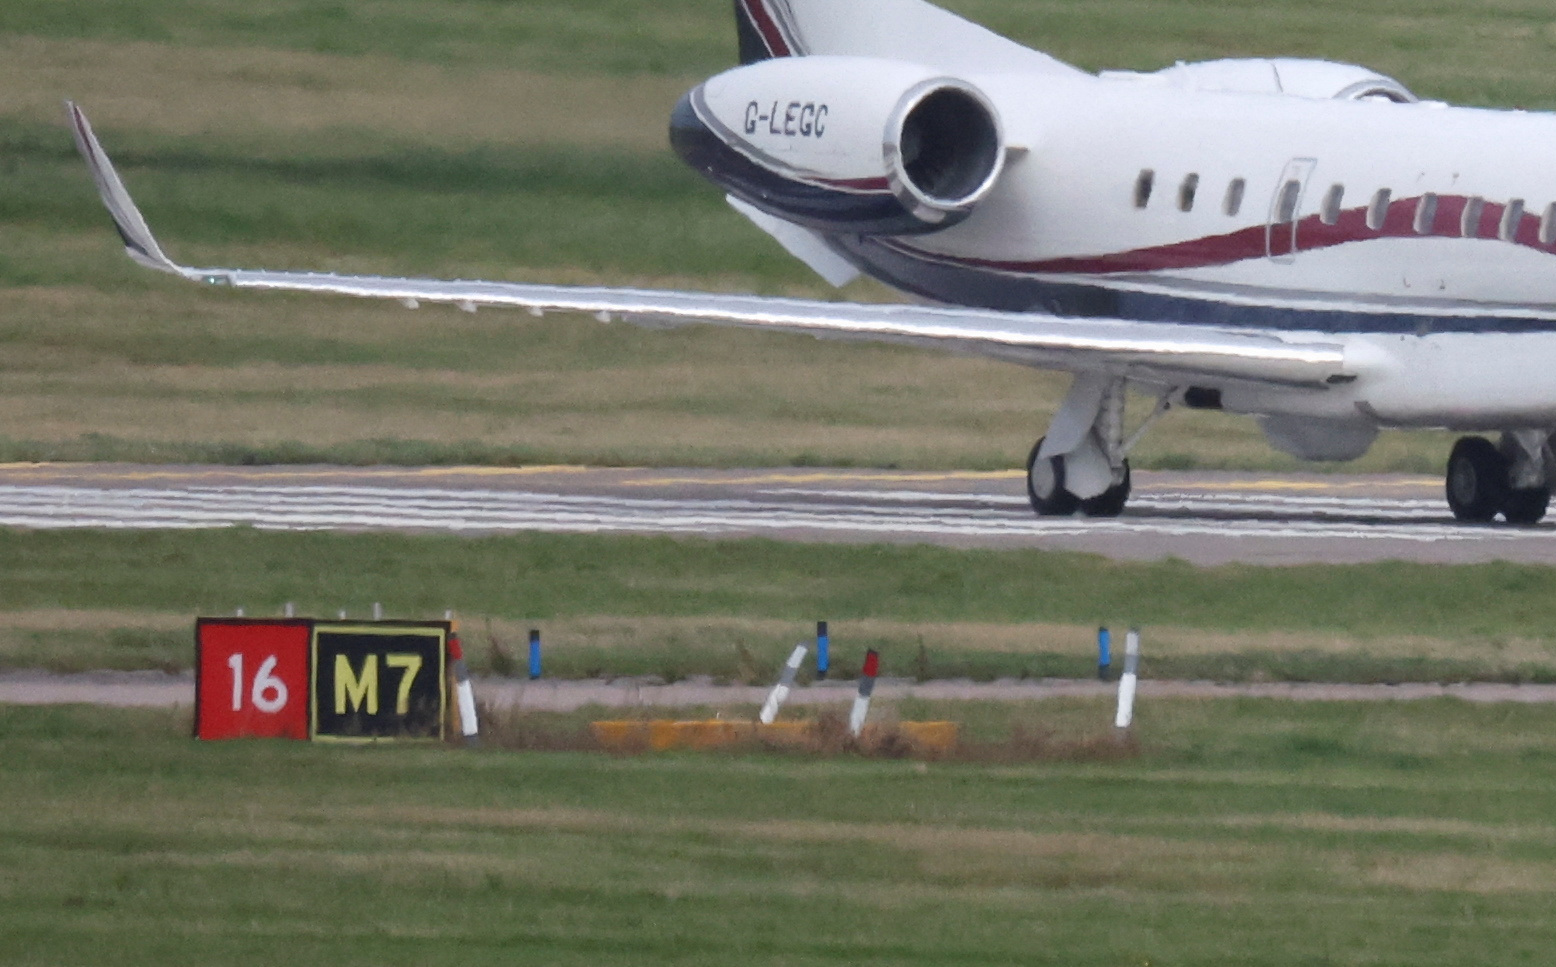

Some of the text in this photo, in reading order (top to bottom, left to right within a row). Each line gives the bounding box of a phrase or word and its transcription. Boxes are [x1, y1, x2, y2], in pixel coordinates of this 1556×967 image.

[744, 100, 829, 138] G-LEGC
[227, 652, 288, 714] 16
[334, 653, 423, 716] M7
